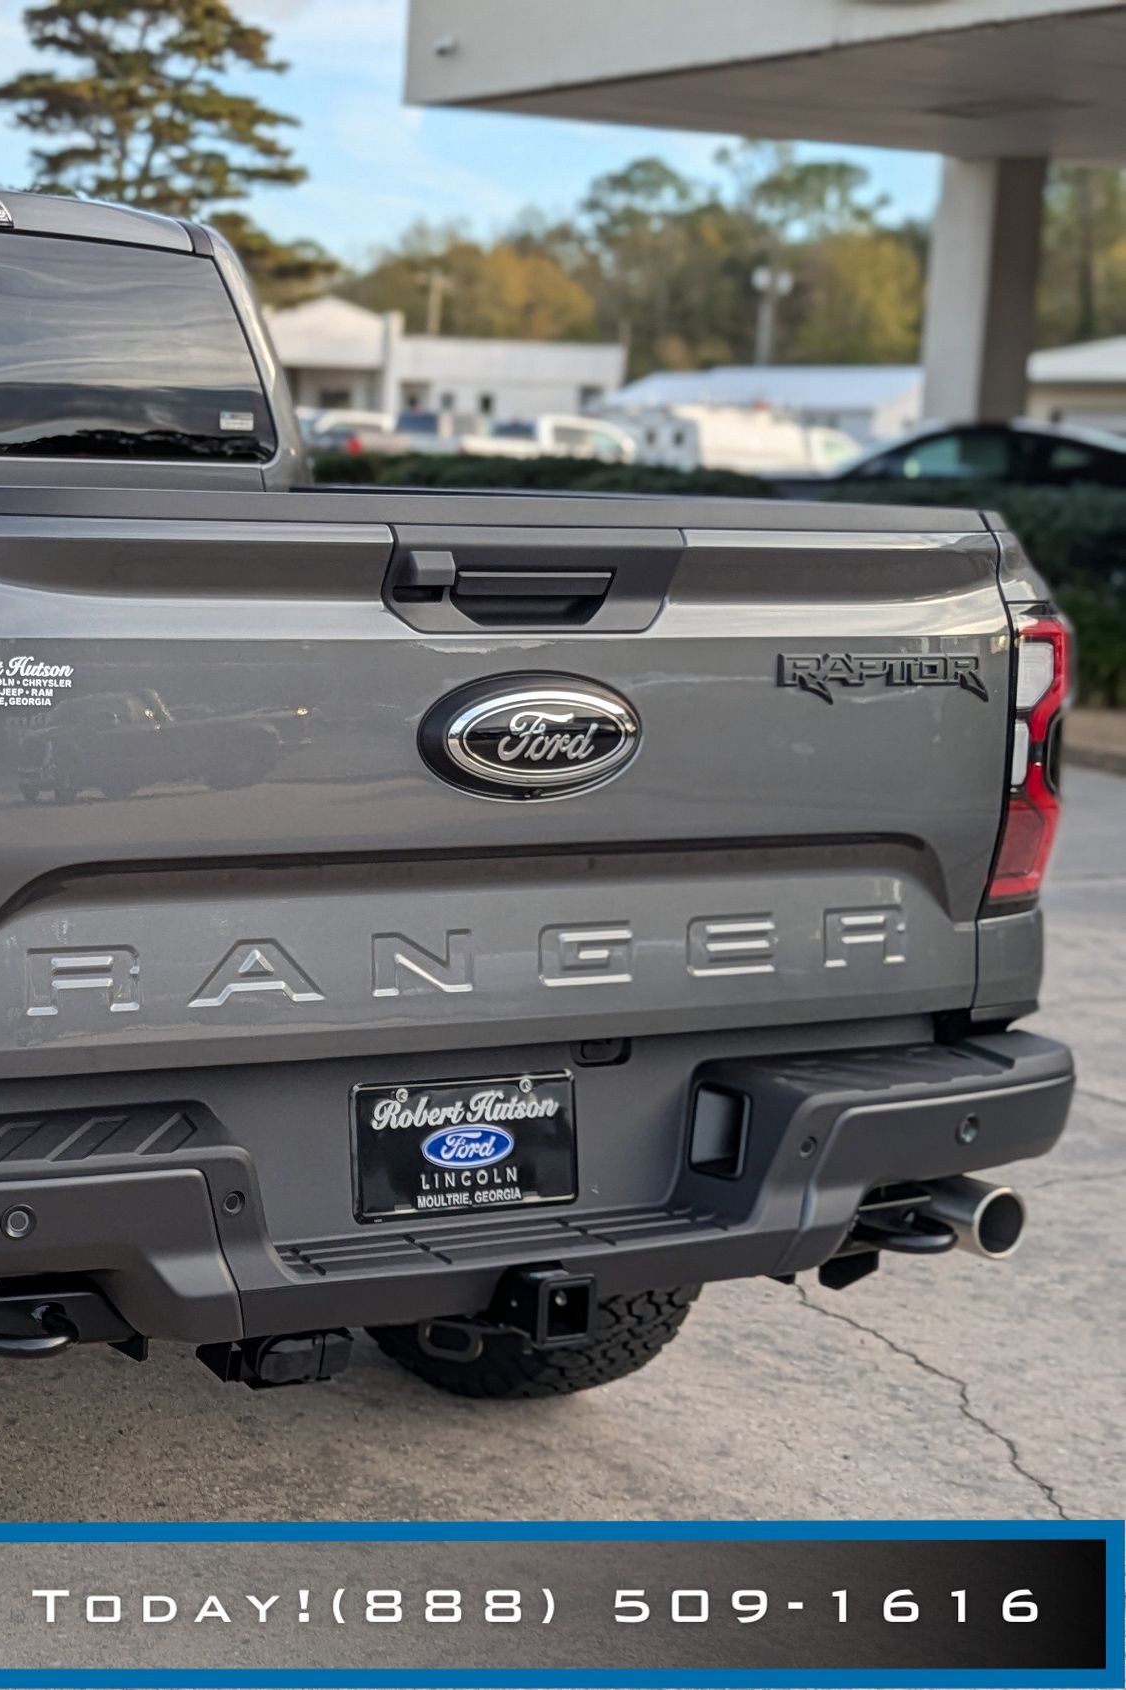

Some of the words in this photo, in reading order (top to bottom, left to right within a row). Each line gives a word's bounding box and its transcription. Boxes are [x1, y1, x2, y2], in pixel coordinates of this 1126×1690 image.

[6, 656, 74, 677] Hutson
[776, 652, 990, 704] RAPTOR
[0, 687, 24, 697] JEEP
[30, 688, 54, 697] RAM
[22, 678, 73, 688] CHRYSLER
[8, 697, 52, 707] GEORGIA
[496, 710, 597, 762] Ford
[25, 904, 906, 1016] RANGER
[372, 1096, 465, 1130] Robert
[466, 1090, 559, 1122] Hutson
[440, 1131, 496, 1160] Ford
[420, 1166, 519, 1190] LINCOLN
[417, 1192, 473, 1209] MOULTRIE,
[474, 1187, 522, 1204] GEORGIA
